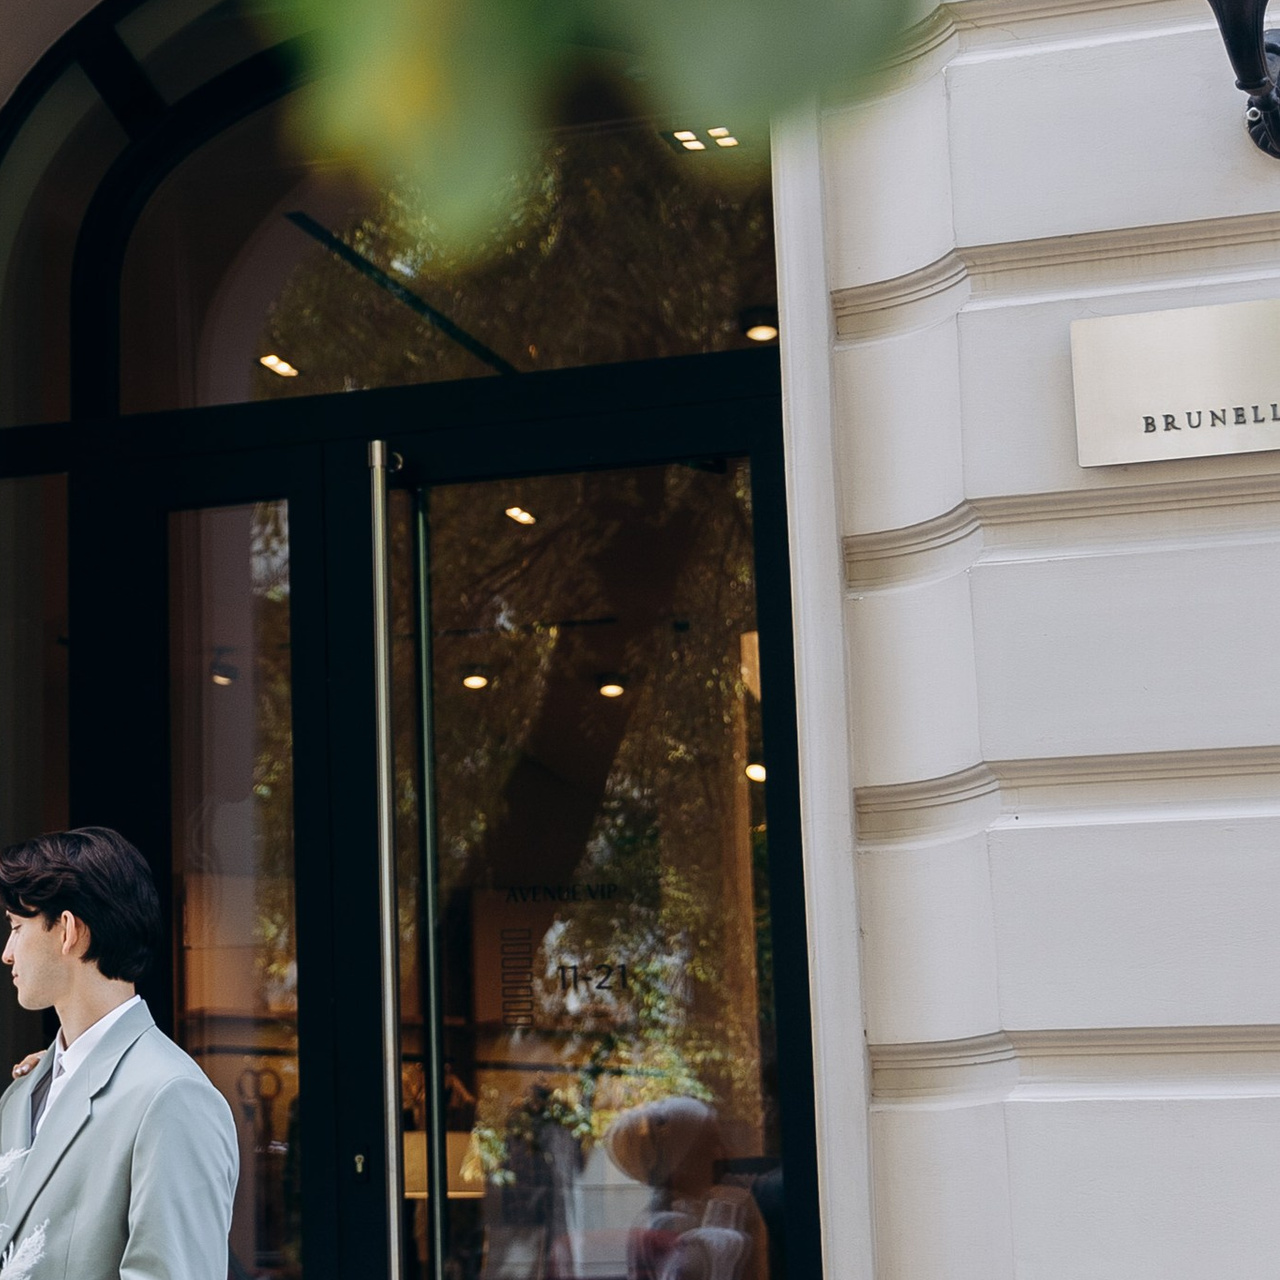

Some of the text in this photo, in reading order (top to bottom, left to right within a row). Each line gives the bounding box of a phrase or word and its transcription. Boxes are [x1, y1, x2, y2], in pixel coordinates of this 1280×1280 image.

[1142, 403, 1280, 433] BRUNELL
[506, 883, 617, 903] AVENUE VIP
[557, 963, 628, 990] 11-21
